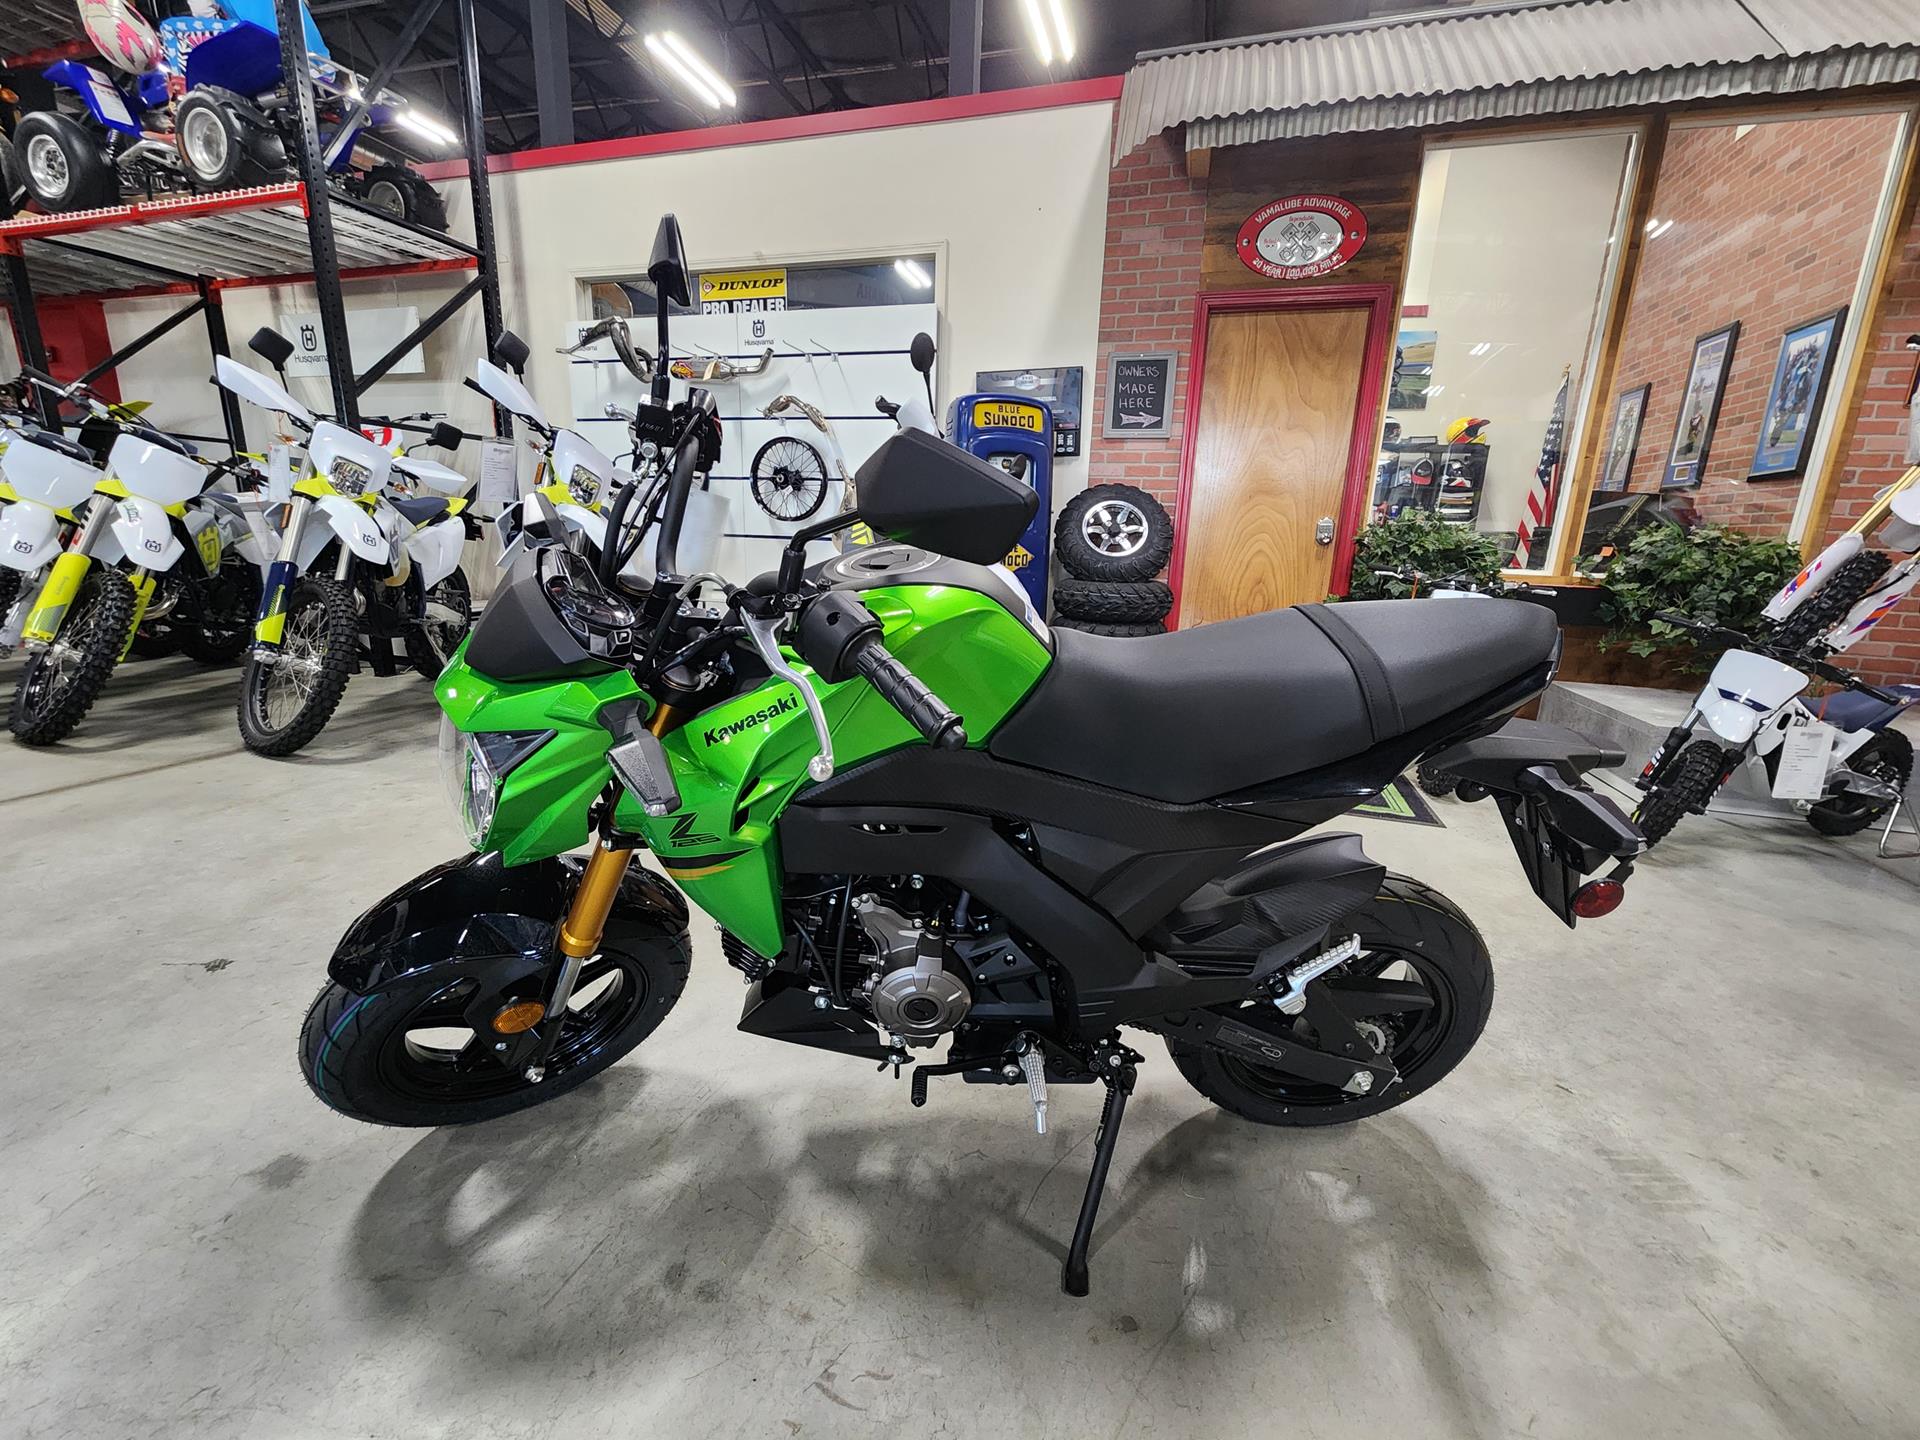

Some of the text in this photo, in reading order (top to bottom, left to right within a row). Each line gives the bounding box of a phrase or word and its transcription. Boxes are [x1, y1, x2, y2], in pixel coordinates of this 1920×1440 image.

[1255, 198, 1353, 224] YAMALUBE ADVANTAGE
[718, 278, 784, 291] DUNLOP
[702, 297, 785, 315] PRO DEALER
[744, 339, 775, 347] Husqvarna
[1118, 364, 1160, 378] OWNERS
[1119, 382, 1157, 395] MADE
[998, 405, 1021, 414] BLUE
[1119, 397, 1154, 409] HERE
[984, 411, 1035, 429] SUNOCO
[703, 692, 799, 748] Kawasaki
[672, 832, 722, 848] 125
